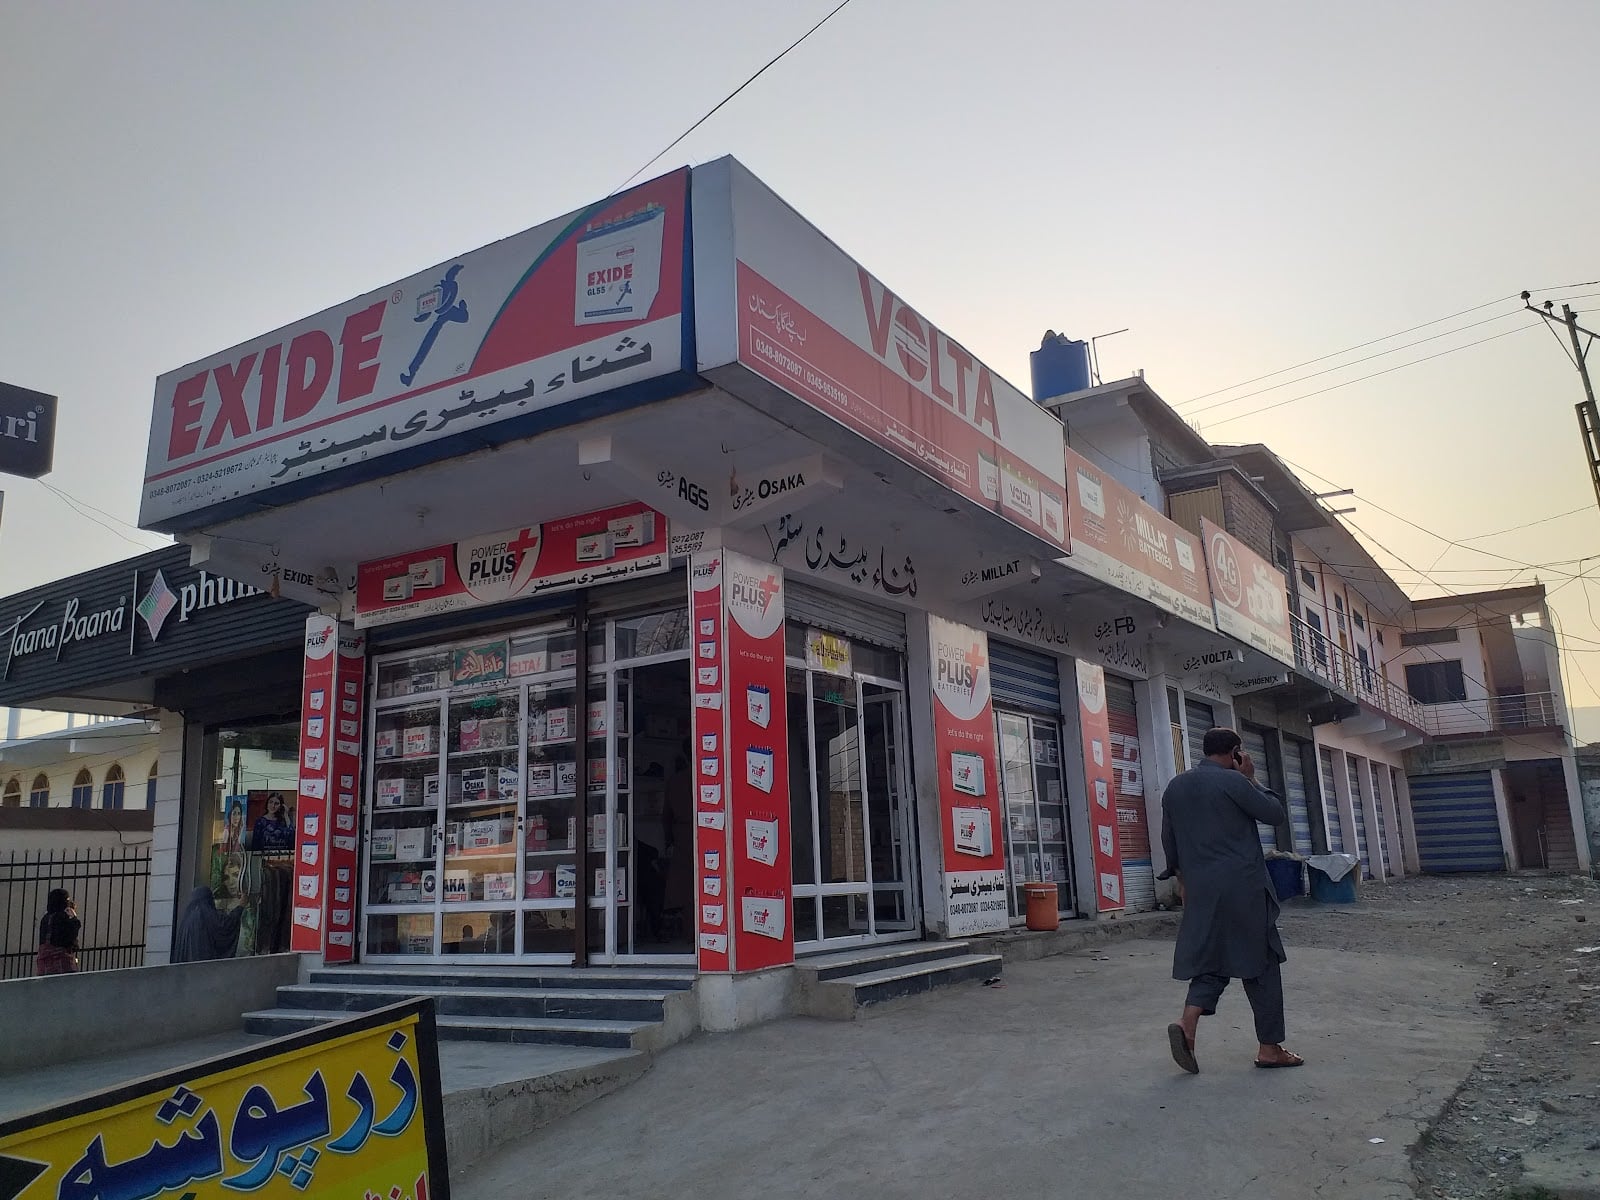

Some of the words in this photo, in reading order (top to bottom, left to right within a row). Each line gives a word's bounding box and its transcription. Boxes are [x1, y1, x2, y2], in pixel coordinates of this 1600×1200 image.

[587, 263, 632, 286] EXIDE
[857, 264, 1001, 440] VOLTA
[544, 336, 652, 394] ثناء
[756, 338, 803, 377] 0348-8072087
[806, 371, 848, 406] 0345-9535199
[168, 299, 388, 461] EXIDE
[390, 378, 535, 441] بیٹری
[271, 423, 386, 478] سنٹر
[678, 476, 709, 511] AGS
[758, 473, 805, 499] OSAKA
[1010, 483, 1032, 508] VOLTA
[1135, 513, 1168, 554] MILLAT
[471, 543, 507, 561] POWER
[629, 555, 662, 573] ثناء
[805, 525, 868, 584] بیٹری
[1139, 538, 1173, 570] BATTERIES
[1217, 541, 1236, 585] 4G
[283, 568, 314, 586] EXIDE
[469, 553, 516, 581] PLUS
[577, 564, 628, 585] بیٹری
[693, 567, 712, 577] PLUS
[733, 571, 760, 588] POWER
[872, 546, 918, 598] ثناء
[981, 560, 1021, 583] MILLAT
[468, 574, 512, 589] BATTERIES
[531, 577, 576, 593] سنٹر
[732, 583, 766, 608] PLUS
[1114, 616, 1136, 636] FB
[0, 601, 57, 681] Taana
[56, 598, 123, 662] Baana
[307, 637, 325, 647] PLUS
[938, 642, 965, 663] POWER
[1201, 649, 1234, 665] VOLTA
[938, 659, 973, 688] PLUS
[1247, 674, 1279, 687] PHOENIX
[961, 828, 973, 839] PLUS
